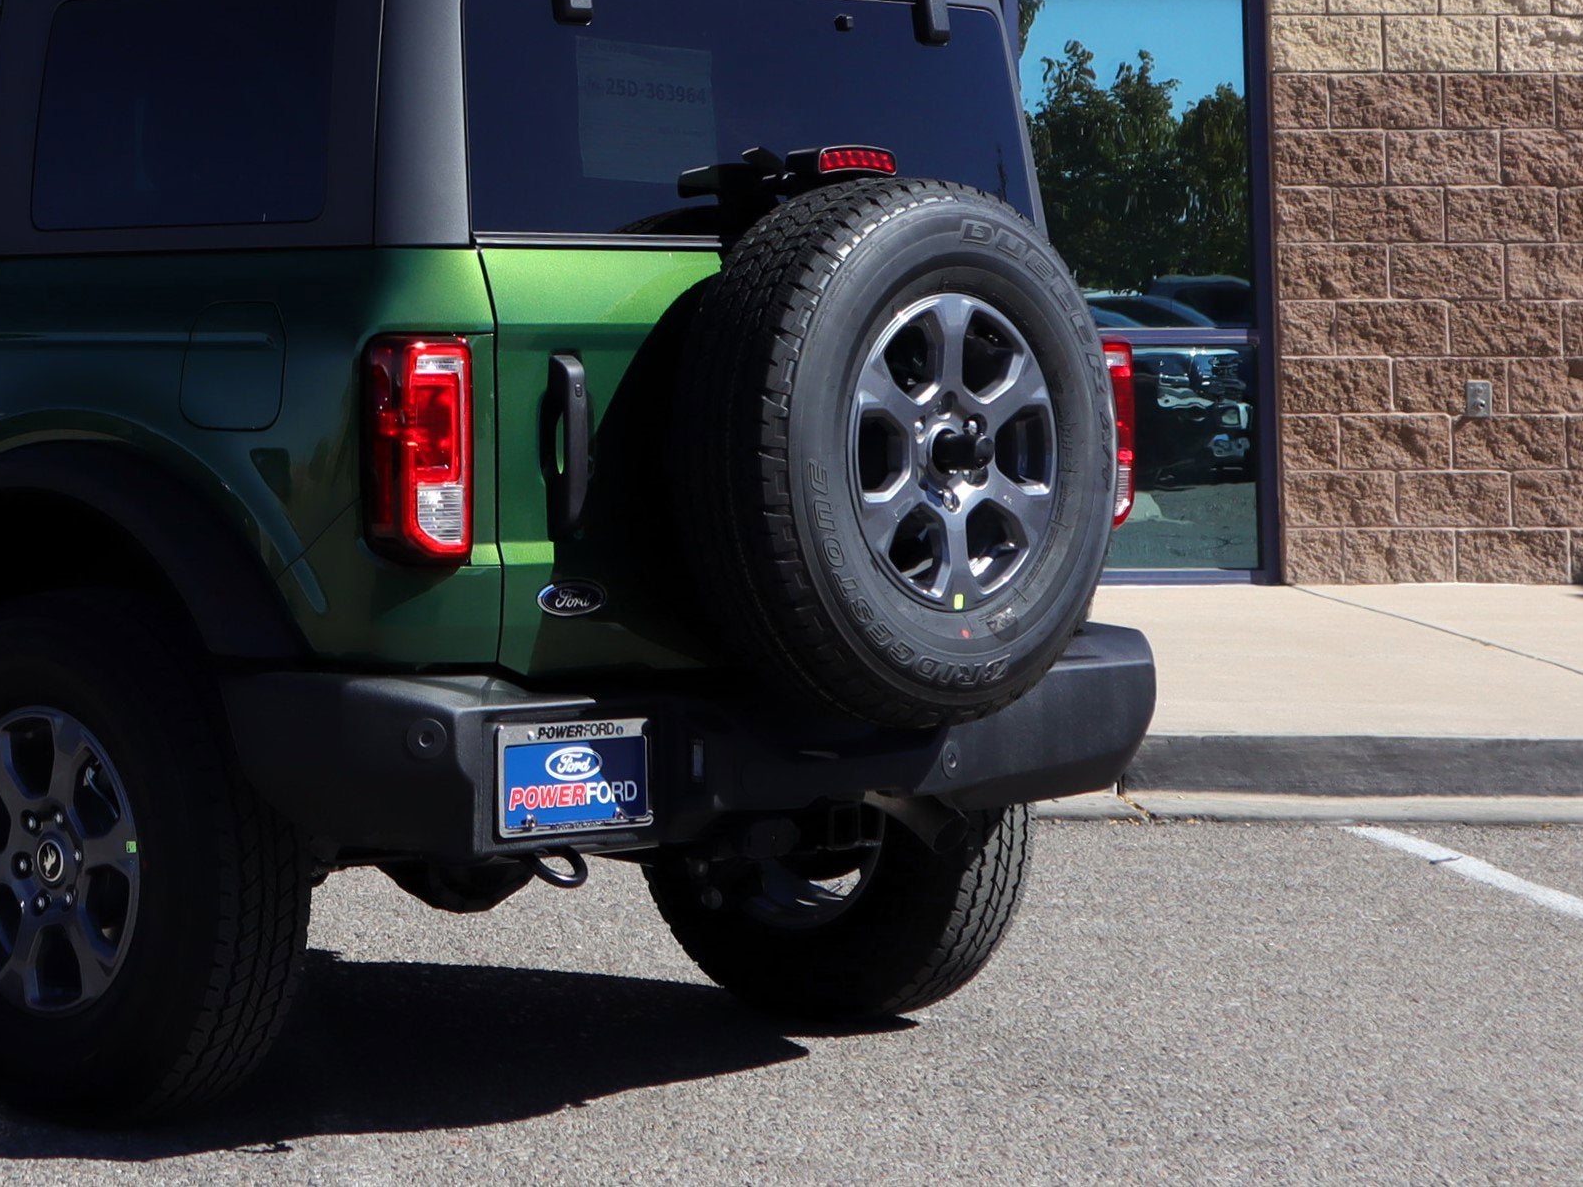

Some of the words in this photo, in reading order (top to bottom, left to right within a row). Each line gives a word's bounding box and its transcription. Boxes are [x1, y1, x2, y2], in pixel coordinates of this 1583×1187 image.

[959, 218, 1107, 395] DUELER
[808, 458, 1012, 689] BRIDGESTONE
[554, 587, 591, 609] Ford
[537, 722, 615, 740] POWERFORD
[556, 752, 592, 774] Ford
[508, 779, 638, 811] POWERFORD
